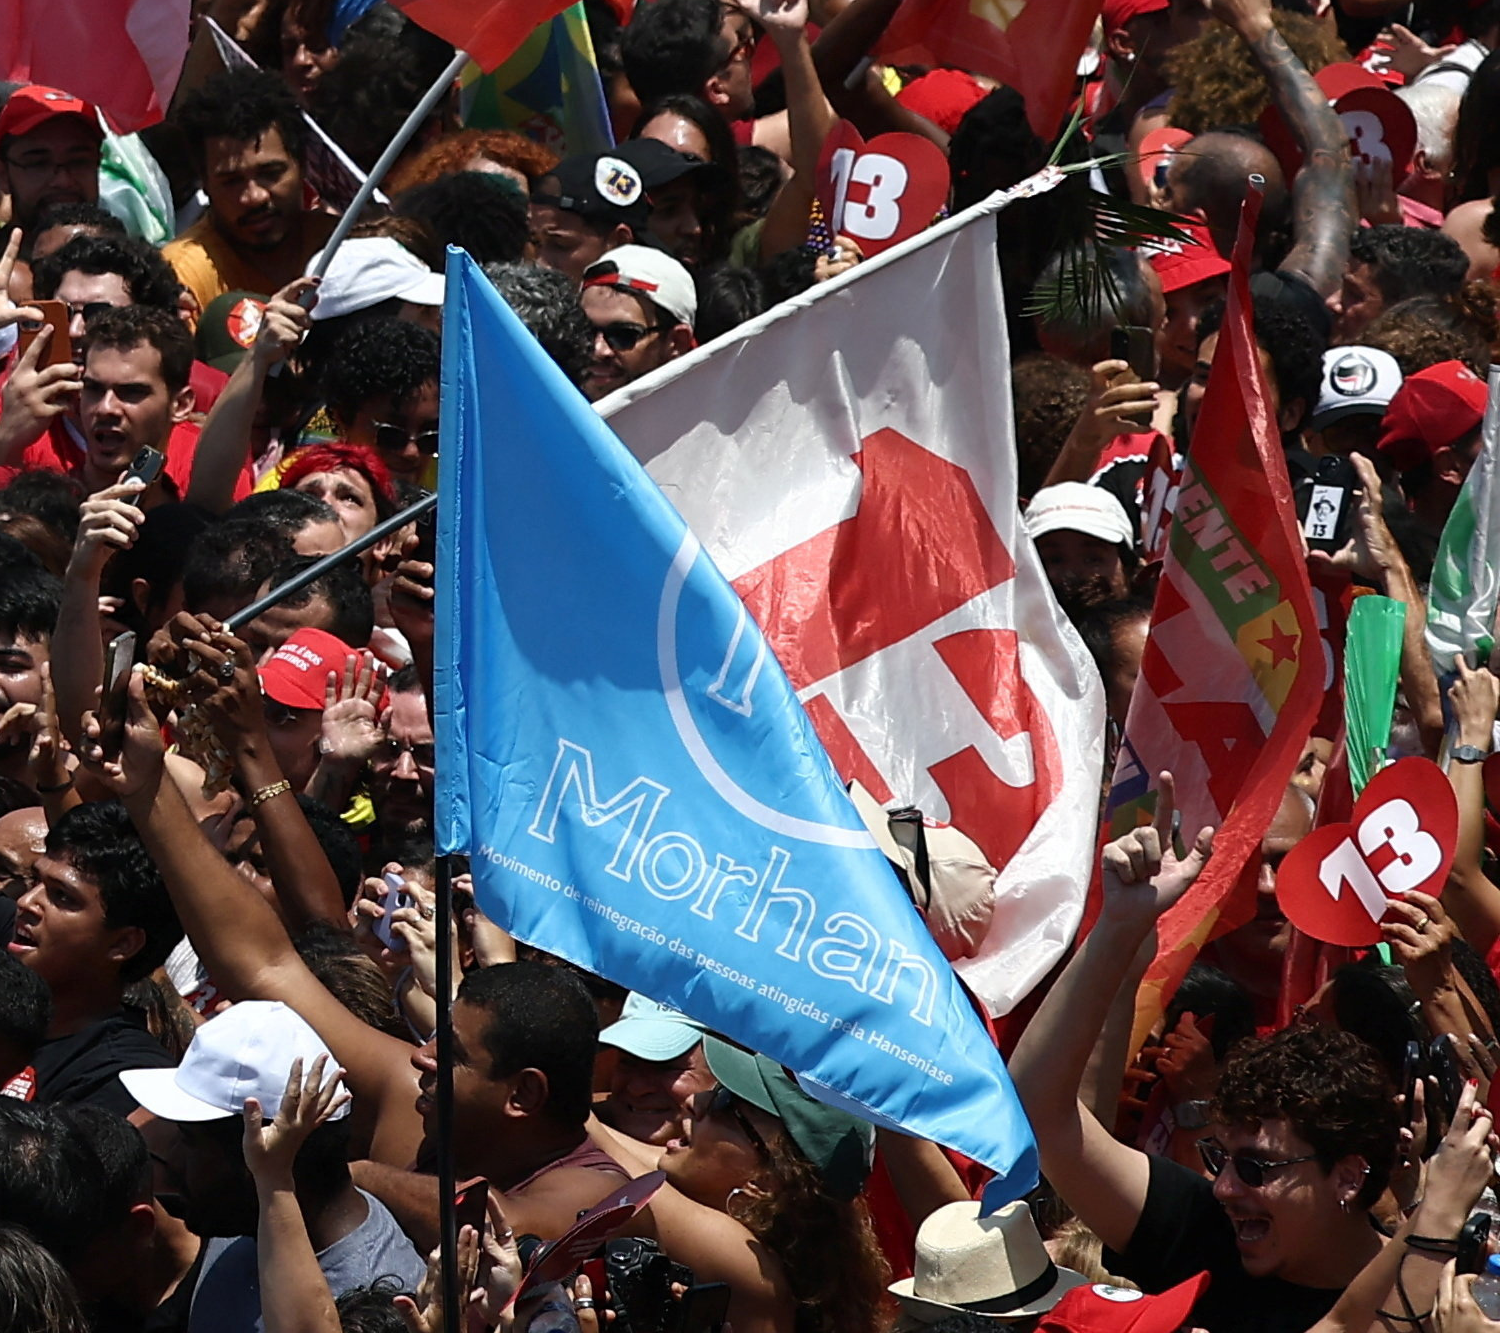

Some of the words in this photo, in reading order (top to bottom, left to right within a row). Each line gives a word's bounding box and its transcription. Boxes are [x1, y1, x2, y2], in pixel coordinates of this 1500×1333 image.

[607, 167, 638, 196] 13
[830, 147, 909, 241] 13
[1311, 523, 1327, 538] 13
[527, 738, 938, 1026] Morhan
[1317, 797, 1443, 926] 13
[477, 843, 561, 892] Movimento
[563, 883, 582, 903] de
[582, 893, 667, 948] reintegração
[668, 936, 695, 964] das
[694, 952, 758, 999] pessoas
[757, 982, 830, 1027] atingidas
[829, 1014, 865, 1045] pela
